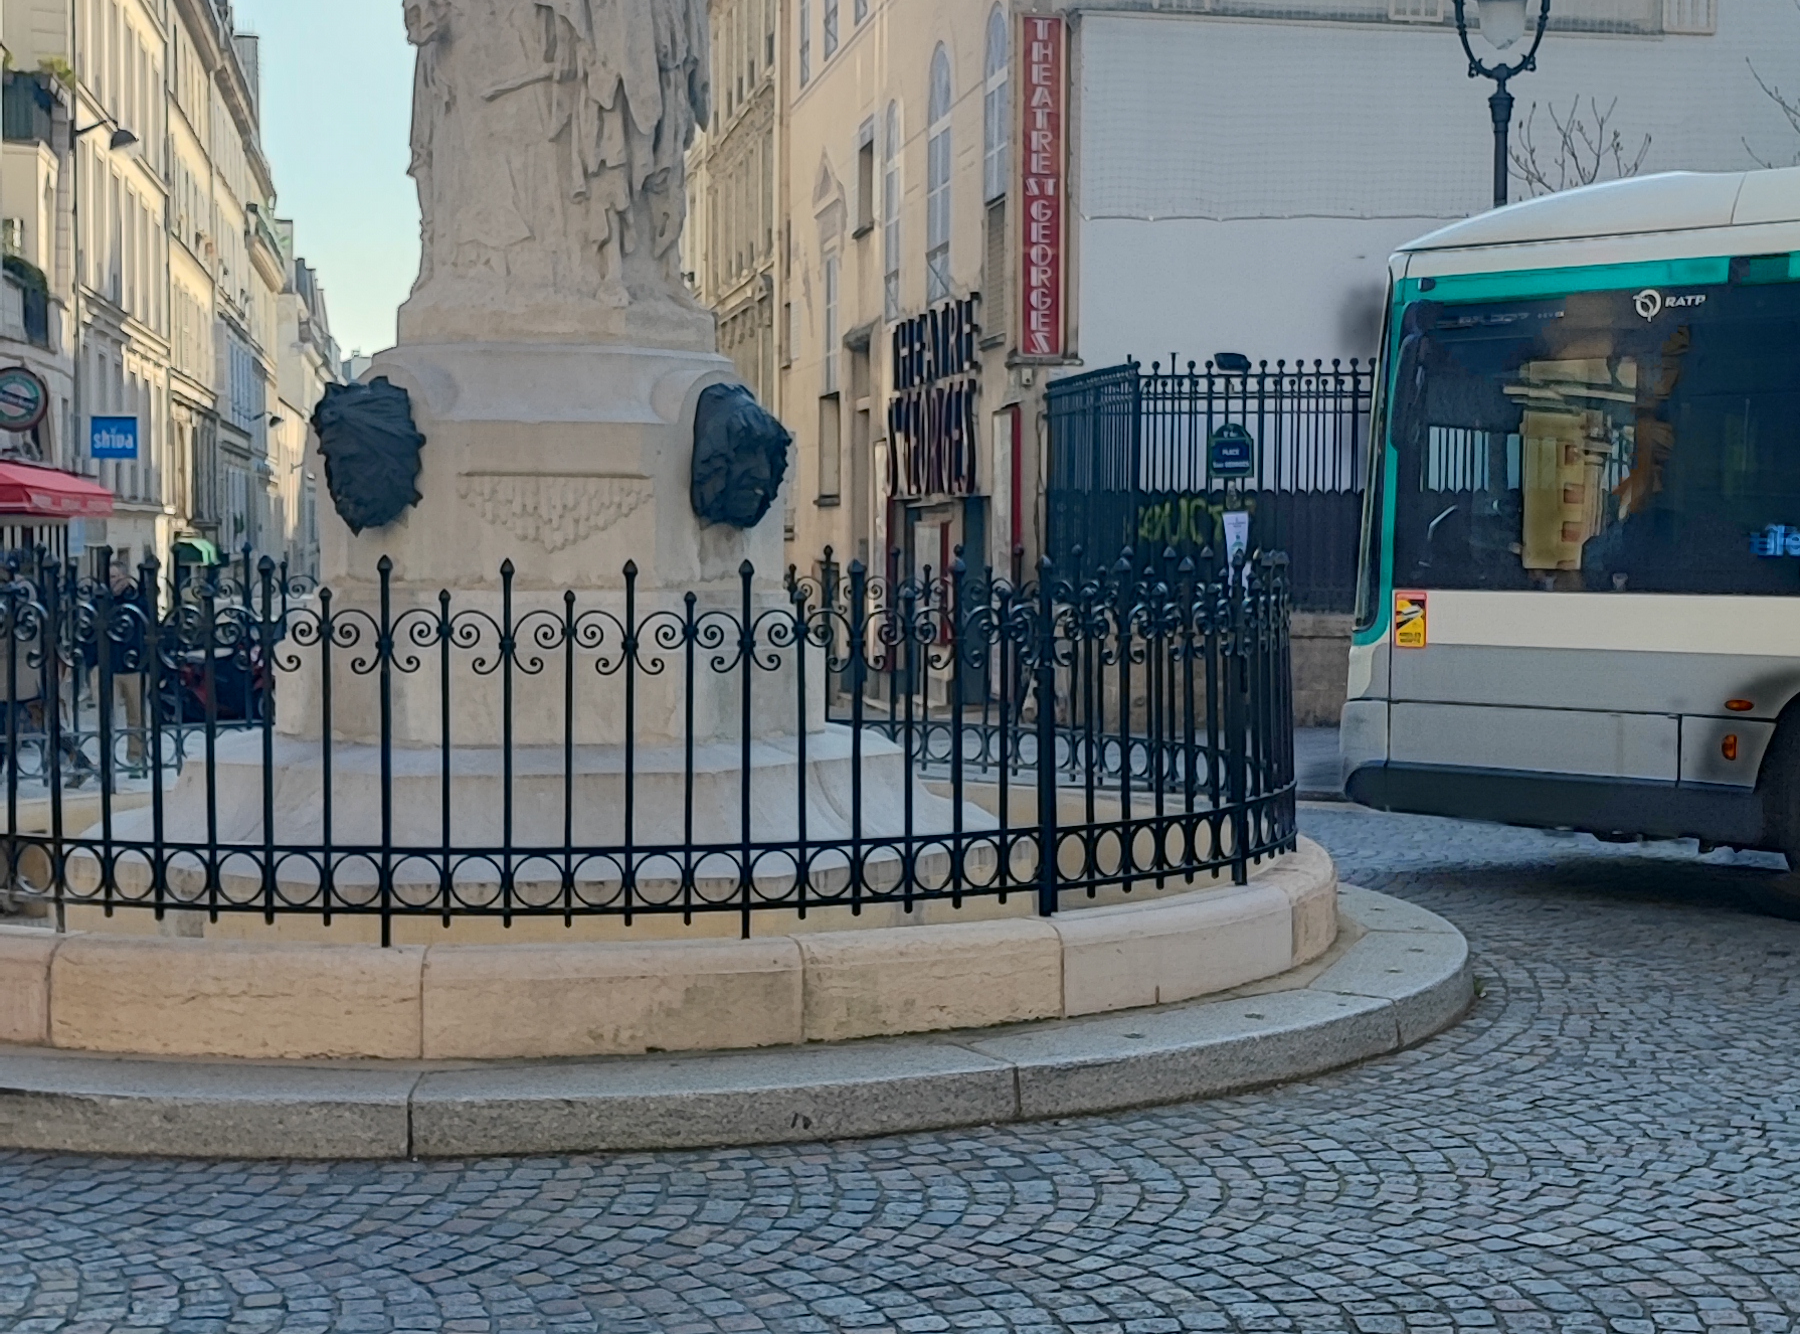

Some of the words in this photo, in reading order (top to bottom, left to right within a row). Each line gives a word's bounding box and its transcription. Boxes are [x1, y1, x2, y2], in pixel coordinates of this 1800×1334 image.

[1030, 19, 1053, 175] THEATRE
[1025, 177, 1057, 197] ST
[1029, 199, 1053, 354] GEORGES
[1664, 294, 1706, 308] RATP
[888, 292, 981, 391] THEATRE
[93, 426, 134, 449] shiva
